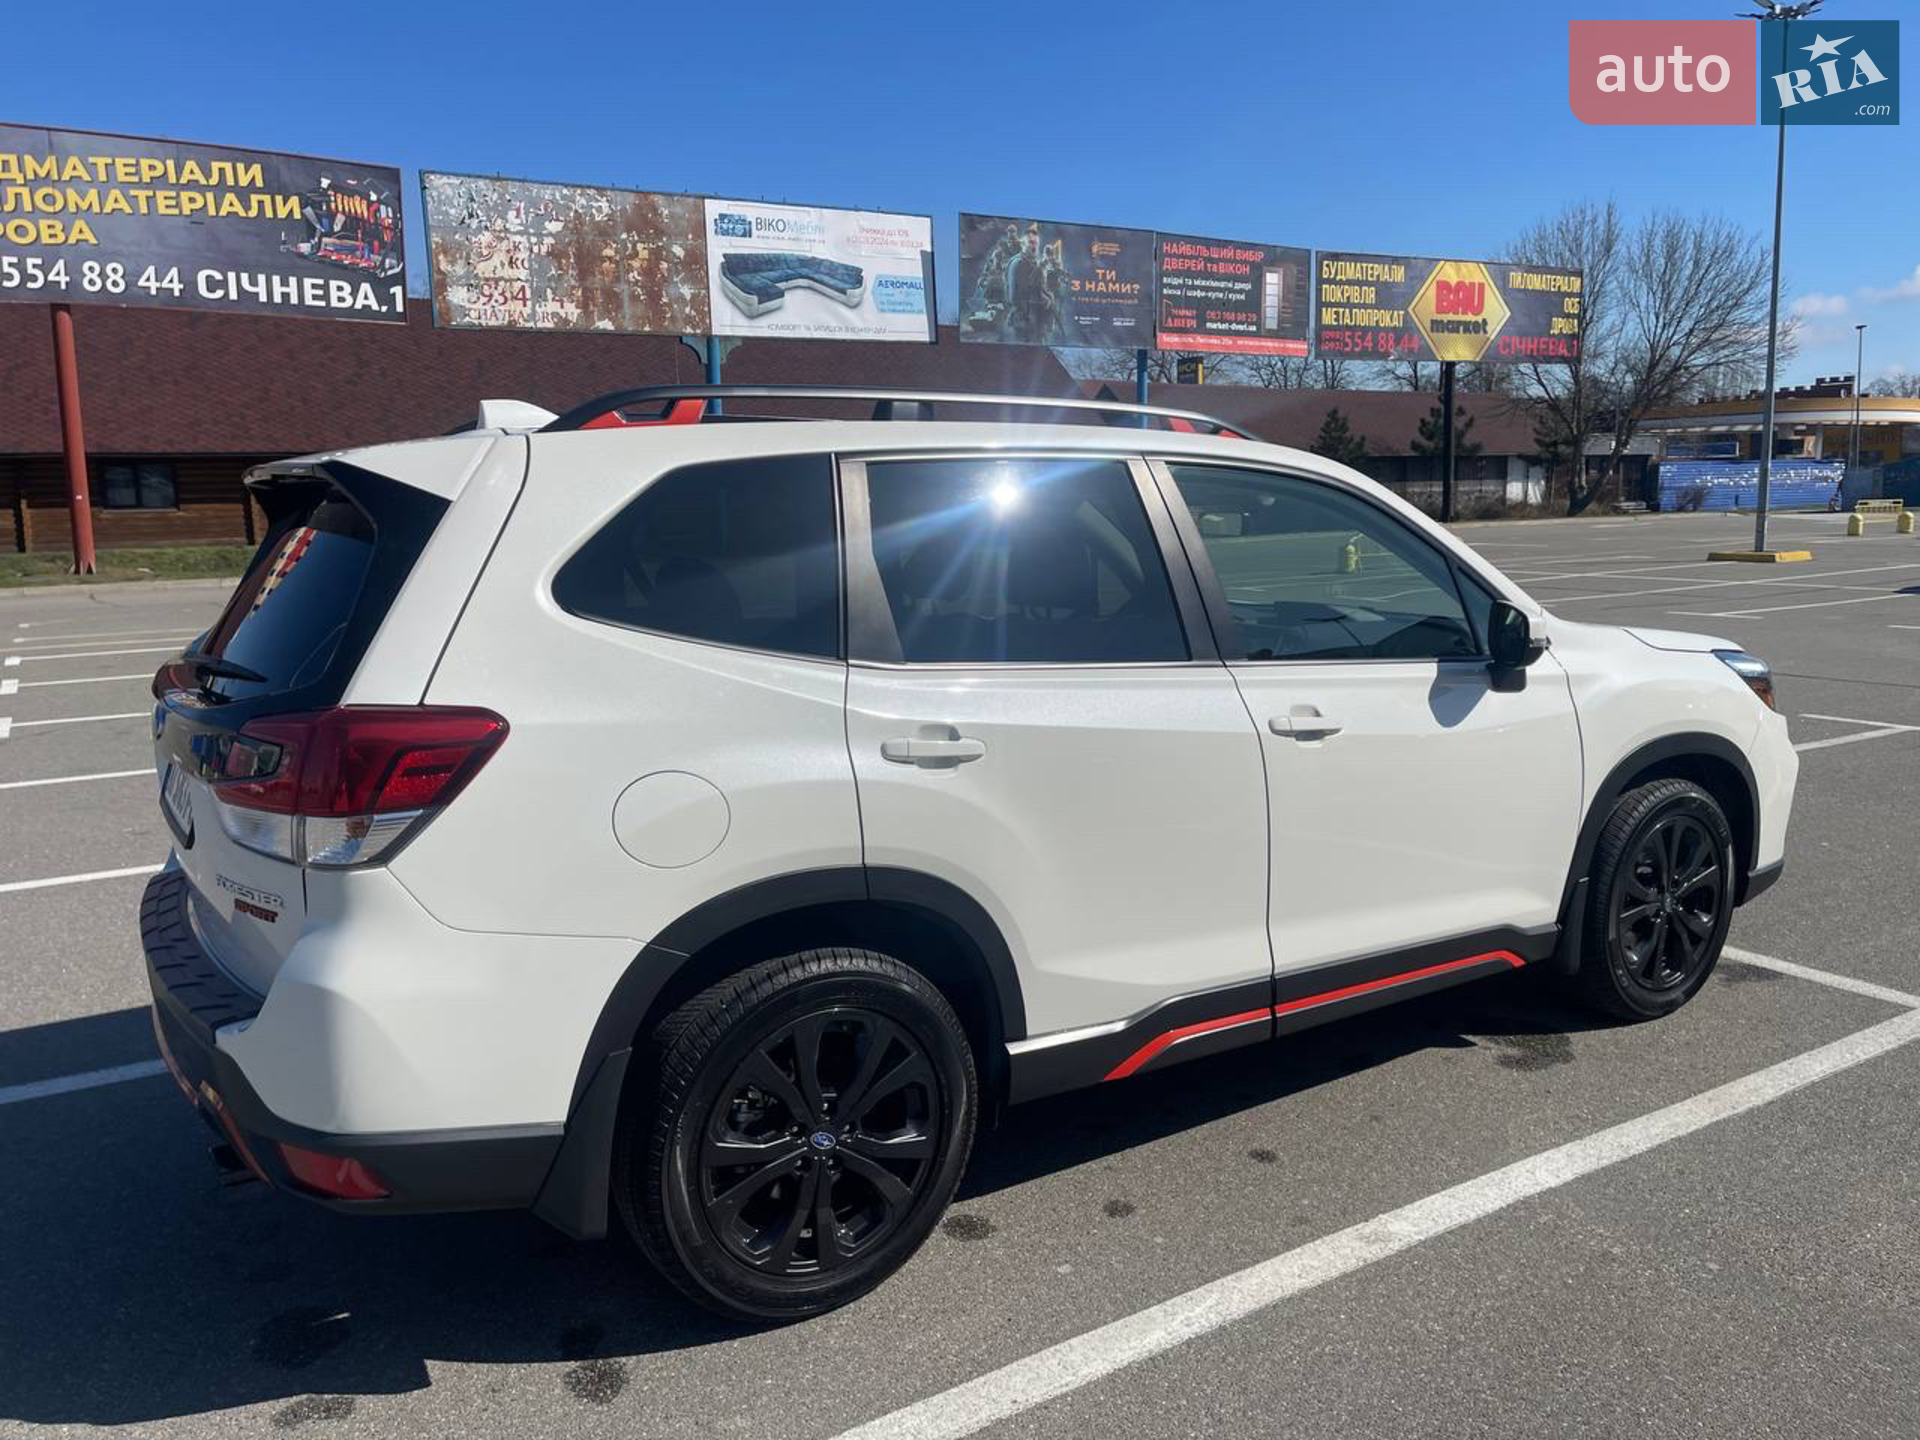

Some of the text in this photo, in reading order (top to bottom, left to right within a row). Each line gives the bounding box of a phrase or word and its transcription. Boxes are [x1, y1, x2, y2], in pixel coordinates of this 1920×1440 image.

[0, 186, 302, 220] ЛОМАТЕРІАЛИ
[1163, 241, 1265, 262] НАЙБІЛЬШИЙ ВИБІР
[1163, 256, 1205, 271] ДВЕРЕЙ
[1322, 260, 1405, 283] БУДМАТЕРІАЛИ
[2, 255, 70, 290] 554
[82, 260, 126, 293] 88
[137, 265, 183, 297] 44
[1095, 268, 1117, 281] ТИ
[1085, 280, 1141, 295] НАМИ?
[1322, 284, 1376, 305] ПОКРІВЛЯ
[1436, 280, 1485, 316] BAU
[1321, 307, 1405, 328] МЕТАЛОПРОКАТ
[1430, 318, 1488, 335] market
[1344, 332, 1372, 352] 554
[1377, 332, 1395, 353] 88
[1400, 334, 1420, 353] 44
